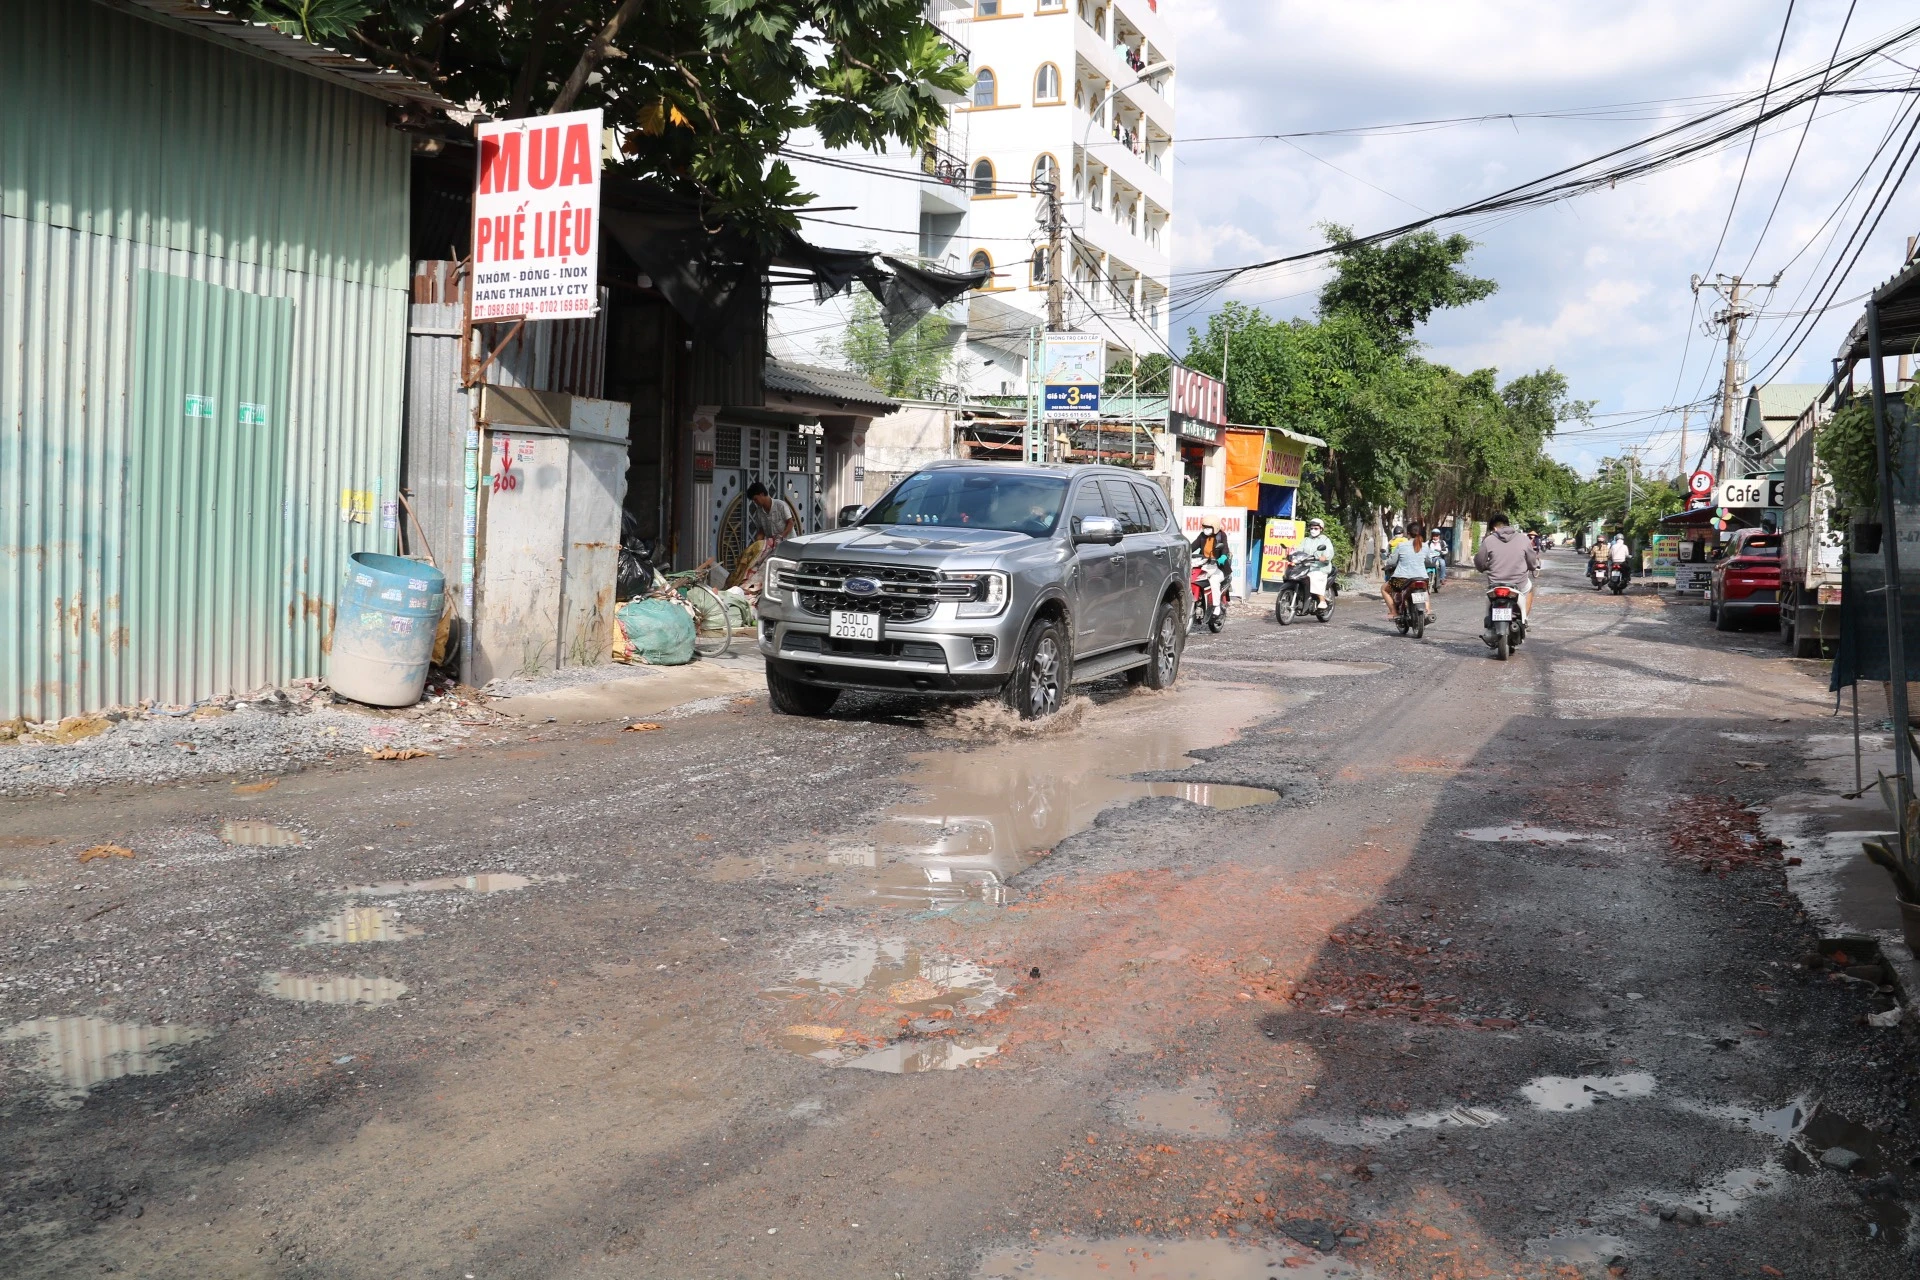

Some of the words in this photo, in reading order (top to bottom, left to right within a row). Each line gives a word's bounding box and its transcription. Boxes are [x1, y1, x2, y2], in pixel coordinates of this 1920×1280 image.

[479, 123, 593, 195] MUA
[476, 200, 530, 264] PHẾ
[533, 201, 592, 264] LIỆU
[477, 270, 510, 285] NHÔM
[519, 266, 550, 281] ĐỒNG
[560, 266, 588, 279] INOX
[475, 287, 506, 301] HÀNG
[509, 286, 547, 299] THANH
[550, 283, 564, 296] LÝ
[567, 284, 589, 295] CTY
[487, 303, 505, 316] 0982
[506, 302, 519, 315] 680
[521, 301, 534, 314] 194
[539, 300, 558, 313] 0702
[560, 299, 573, 312] 169
[574, 298, 589, 311] 658
[1046, 392, 1058, 400] Giá
[1067, 386, 1080, 406] 3
[1080, 392, 1097, 401] triệu
[1172, 365, 1227, 427] HOTEL
[493, 473, 516, 494] 300
[1726, 485, 1760, 502] Cafe
[849, 581, 870, 591] Ford
[841, 612, 868, 626] 50LD
[836, 625, 873, 639] 203.40
